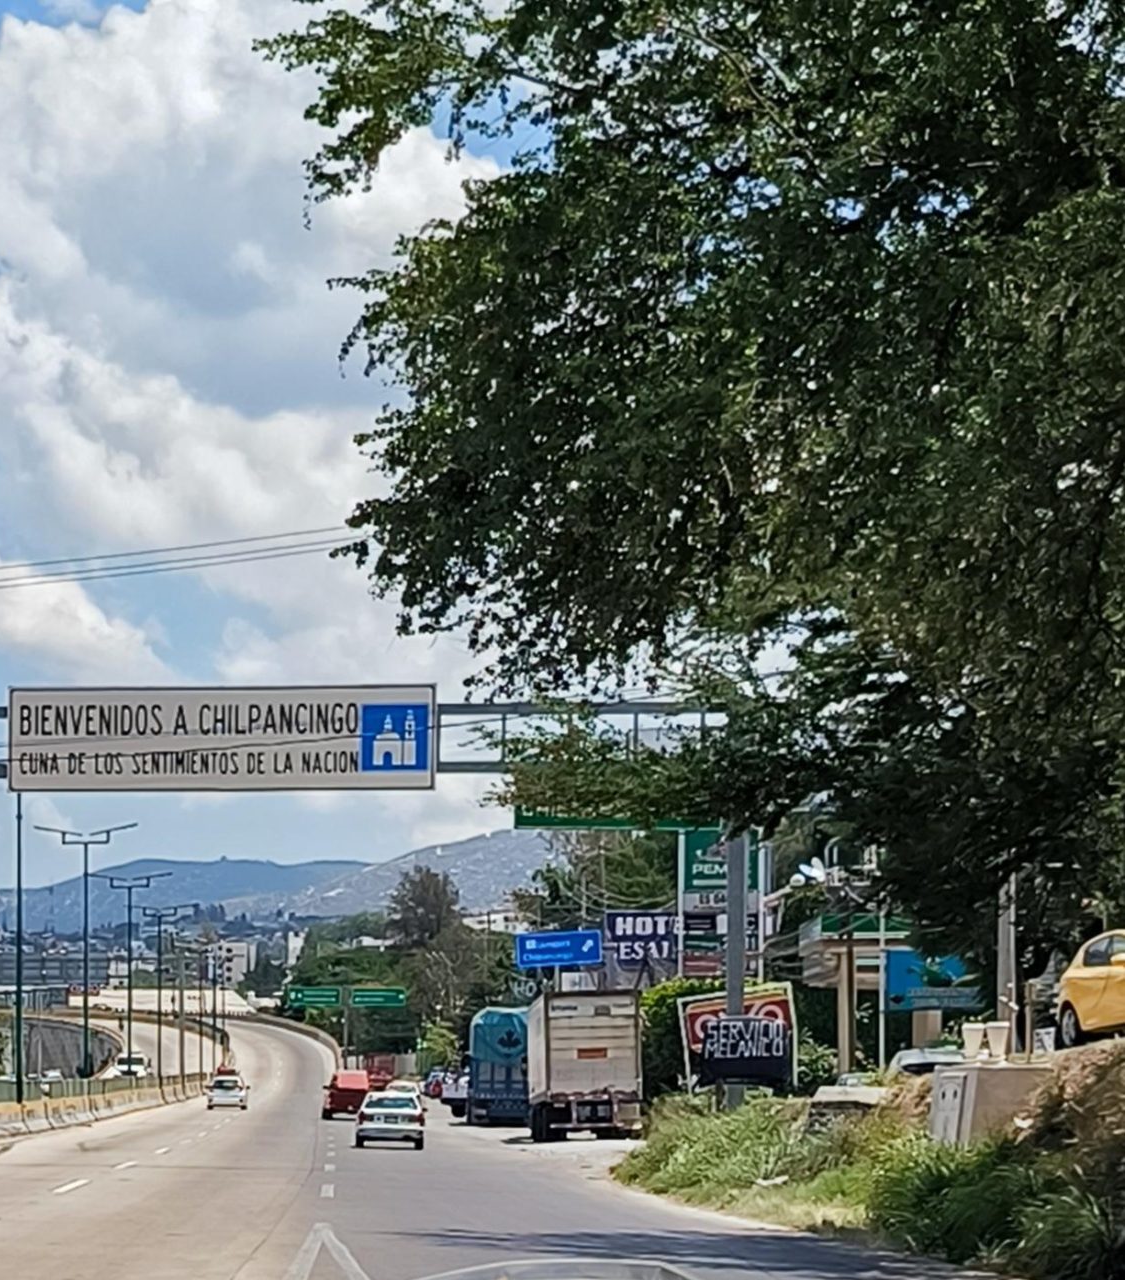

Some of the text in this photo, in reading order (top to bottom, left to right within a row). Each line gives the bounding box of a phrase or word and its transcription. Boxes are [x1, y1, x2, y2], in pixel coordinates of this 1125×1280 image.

[20, 703, 359, 736] BIENVENIDOS A CHILPANCINGO
[20, 751, 359, 775] CUNA DE LOS SENTIMIENTOS DE LA NACION
